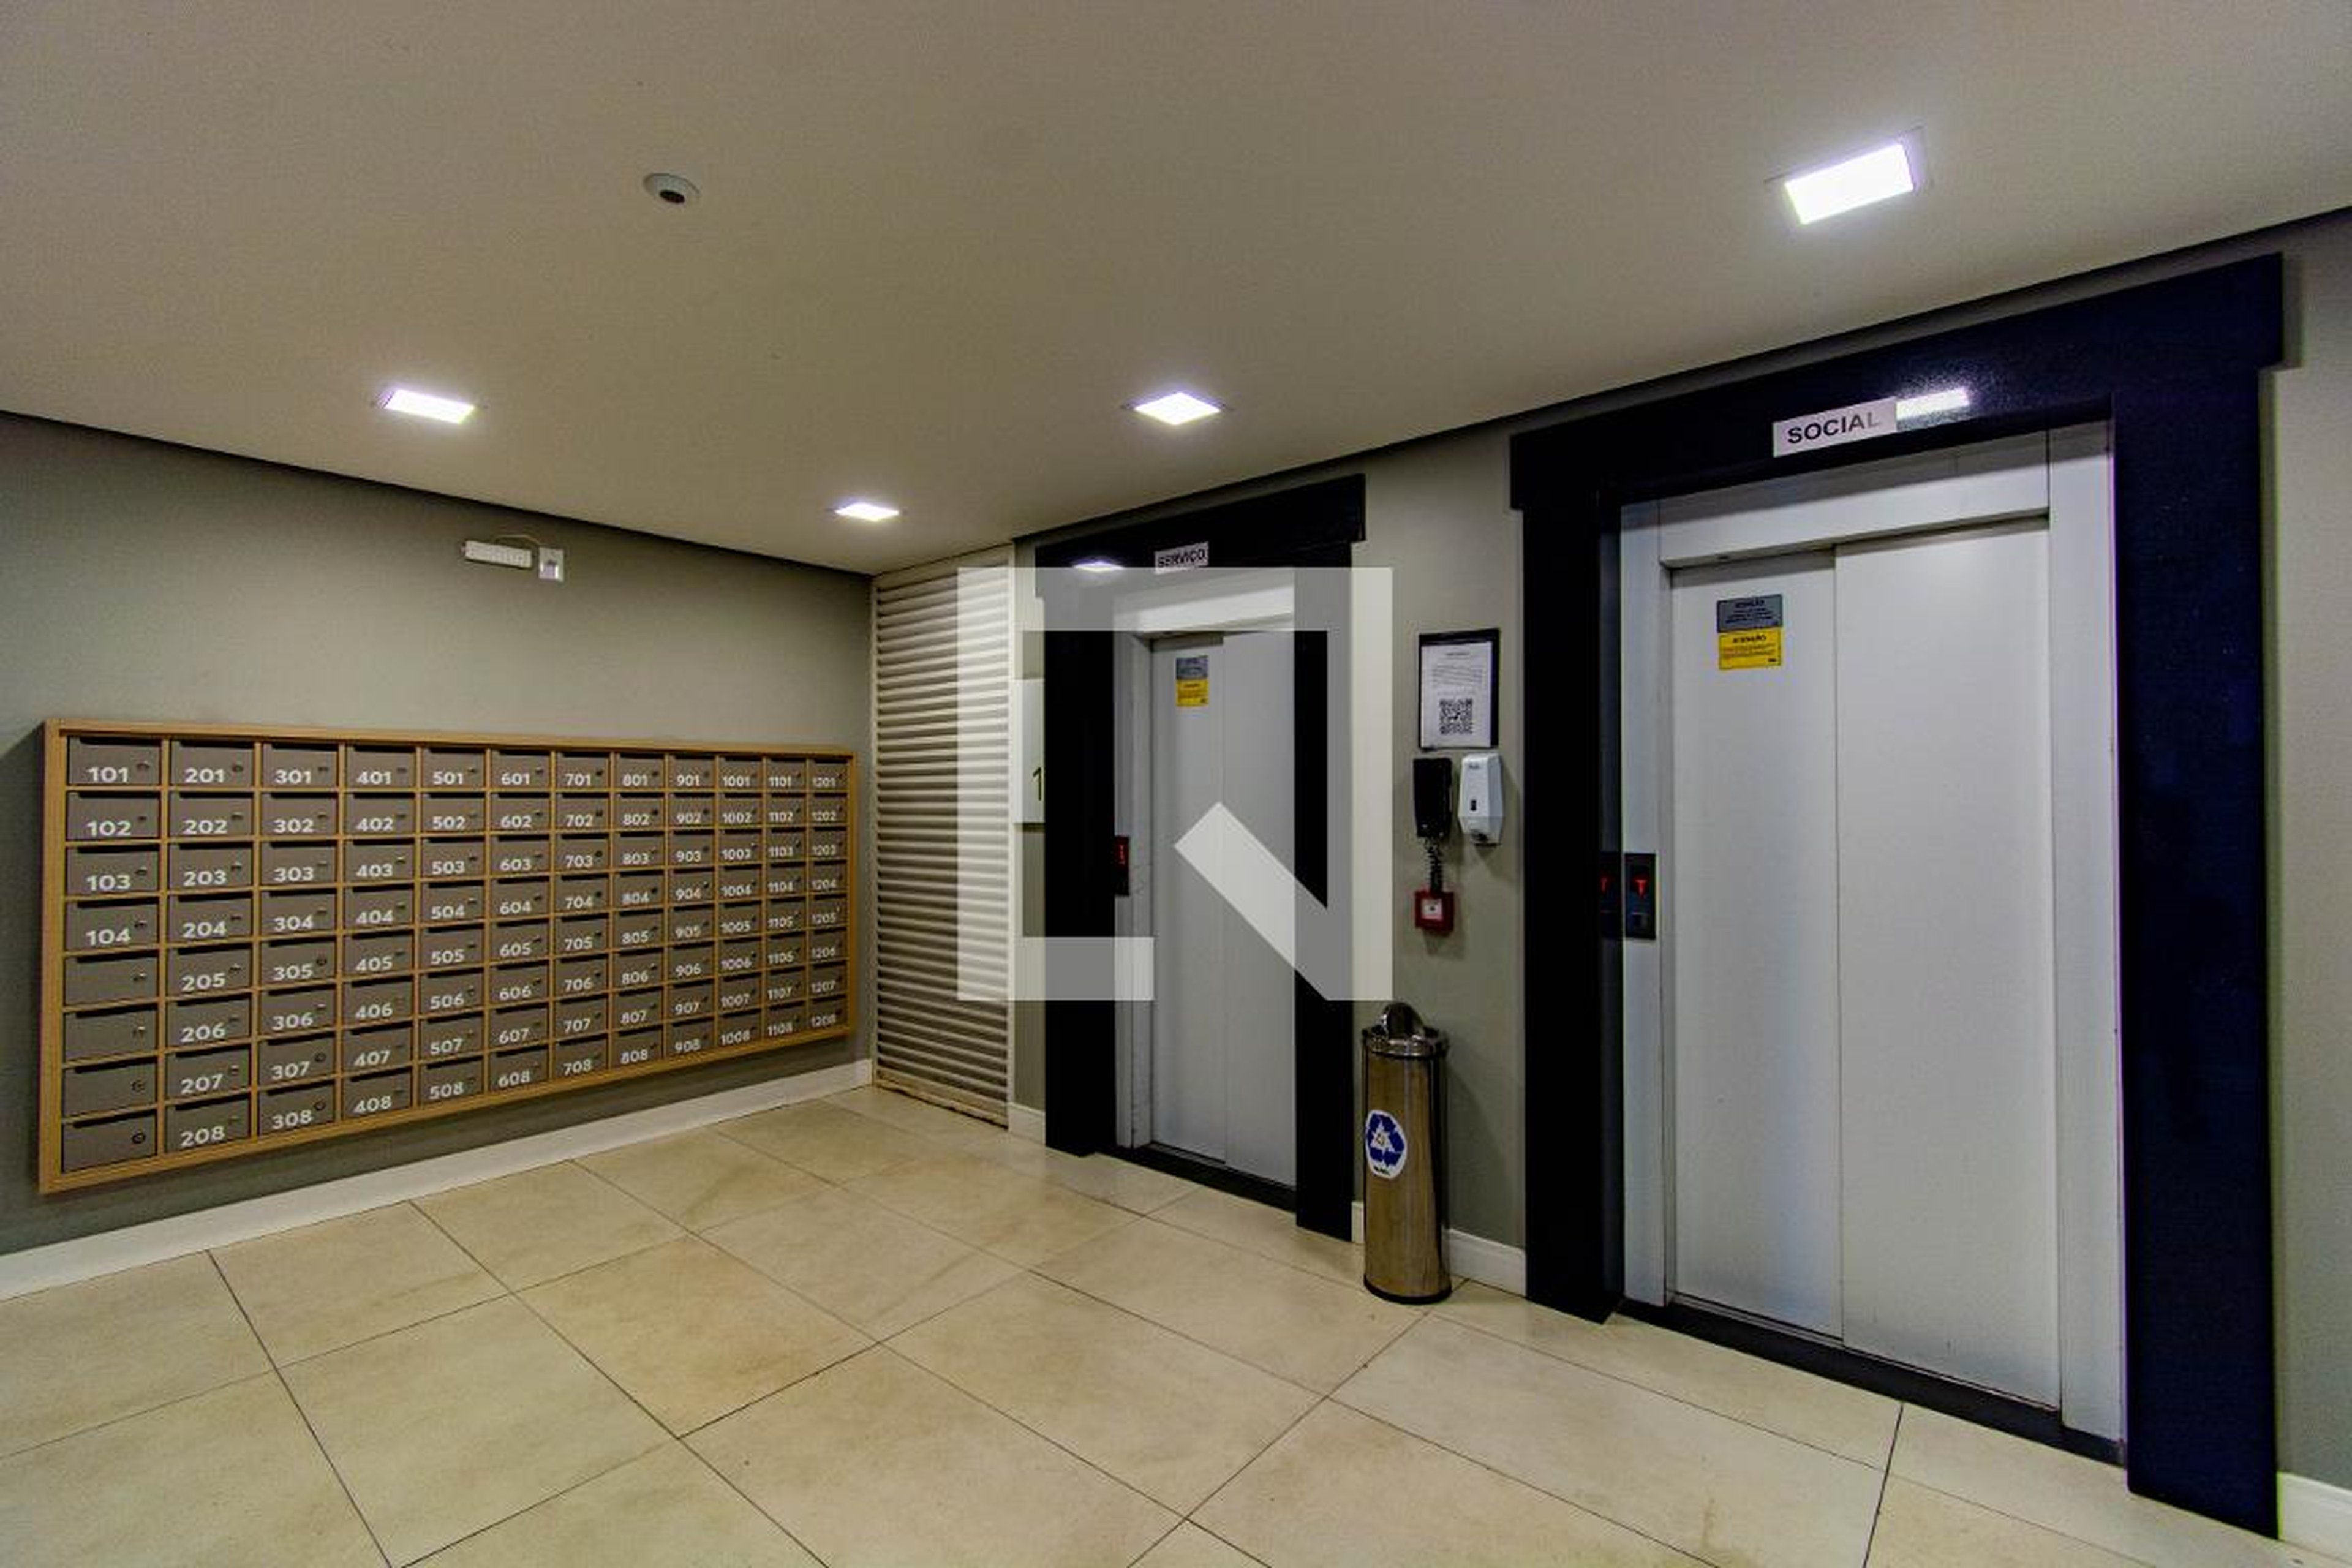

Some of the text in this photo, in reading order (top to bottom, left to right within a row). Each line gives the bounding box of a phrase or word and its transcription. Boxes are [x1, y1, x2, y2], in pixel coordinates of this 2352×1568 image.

[1787, 412, 1882, 444] SOCIAL
[88, 767, 128, 783] 101
[185, 767, 224, 783] 201
[275, 769, 311, 785] 301
[356, 771, 391, 785] 401
[433, 771, 463, 785] 501
[501, 772, 530, 785] 601
[565, 773, 591, 786] 701
[622, 773, 648, 786] 801
[677, 774, 700, 786] 901
[274, 818, 314, 834] 302
[356, 816, 394, 832] 402
[432, 816, 466, 830] 502
[500, 815, 532, 828] 602
[566, 813, 594, 827] 702
[622, 813, 650, 826] 802
[676, 812, 701, 824] 902
[87, 820, 131, 837] 102
[183, 819, 227, 835] 202
[565, 854, 594, 868] 703
[622, 852, 649, 865] 803
[676, 850, 701, 862] 903
[356, 863, 393, 878] 403
[432, 861, 465, 875] 503
[500, 858, 532, 872] 603
[86, 874, 131, 891] 103
[183, 869, 227, 886] 203
[274, 867, 314, 883] 303
[565, 895, 594, 910] 704
[622, 891, 650, 905] 804
[675, 888, 701, 901] 904
[431, 905, 465, 919] 504
[500, 900, 532, 915] 604
[274, 914, 314, 932] 304
[356, 910, 394, 924] 404
[86, 928, 131, 946] 104
[183, 921, 227, 938] 204
[622, 930, 649, 944] 805
[675, 925, 701, 938] 905
[500, 942, 532, 957] 605
[564, 936, 593, 951] 705
[355, 956, 393, 971] 405
[431, 949, 464, 965] 505
[273, 963, 313, 981] 305
[622, 970, 649, 984] 806
[675, 963, 701, 977] 906
[182, 972, 225, 991] 205
[564, 977, 593, 992] 706
[499, 985, 532, 1000] 606
[430, 993, 464, 1010] 506
[675, 1001, 699, 1015] 907
[355, 1002, 393, 1019] 406
[620, 1009, 647, 1025] 807
[272, 1012, 314, 1030] 306
[564, 1017, 591, 1033] 707
[181, 1022, 225, 1042] 206
[499, 1028, 529, 1044] 607
[430, 1038, 463, 1055] 507
[674, 1038, 701, 1054] 908
[354, 1050, 390, 1066] 407
[620, 1049, 648, 1064] 808
[271, 1061, 311, 1080] 307
[564, 1058, 592, 1076] 708
[181, 1073, 223, 1095] 207
[498, 1070, 530, 1087] 608
[430, 1081, 464, 1099] 508
[354, 1095, 392, 1113] 408
[272, 1109, 313, 1129] 308
[181, 1126, 225, 1147] 208
